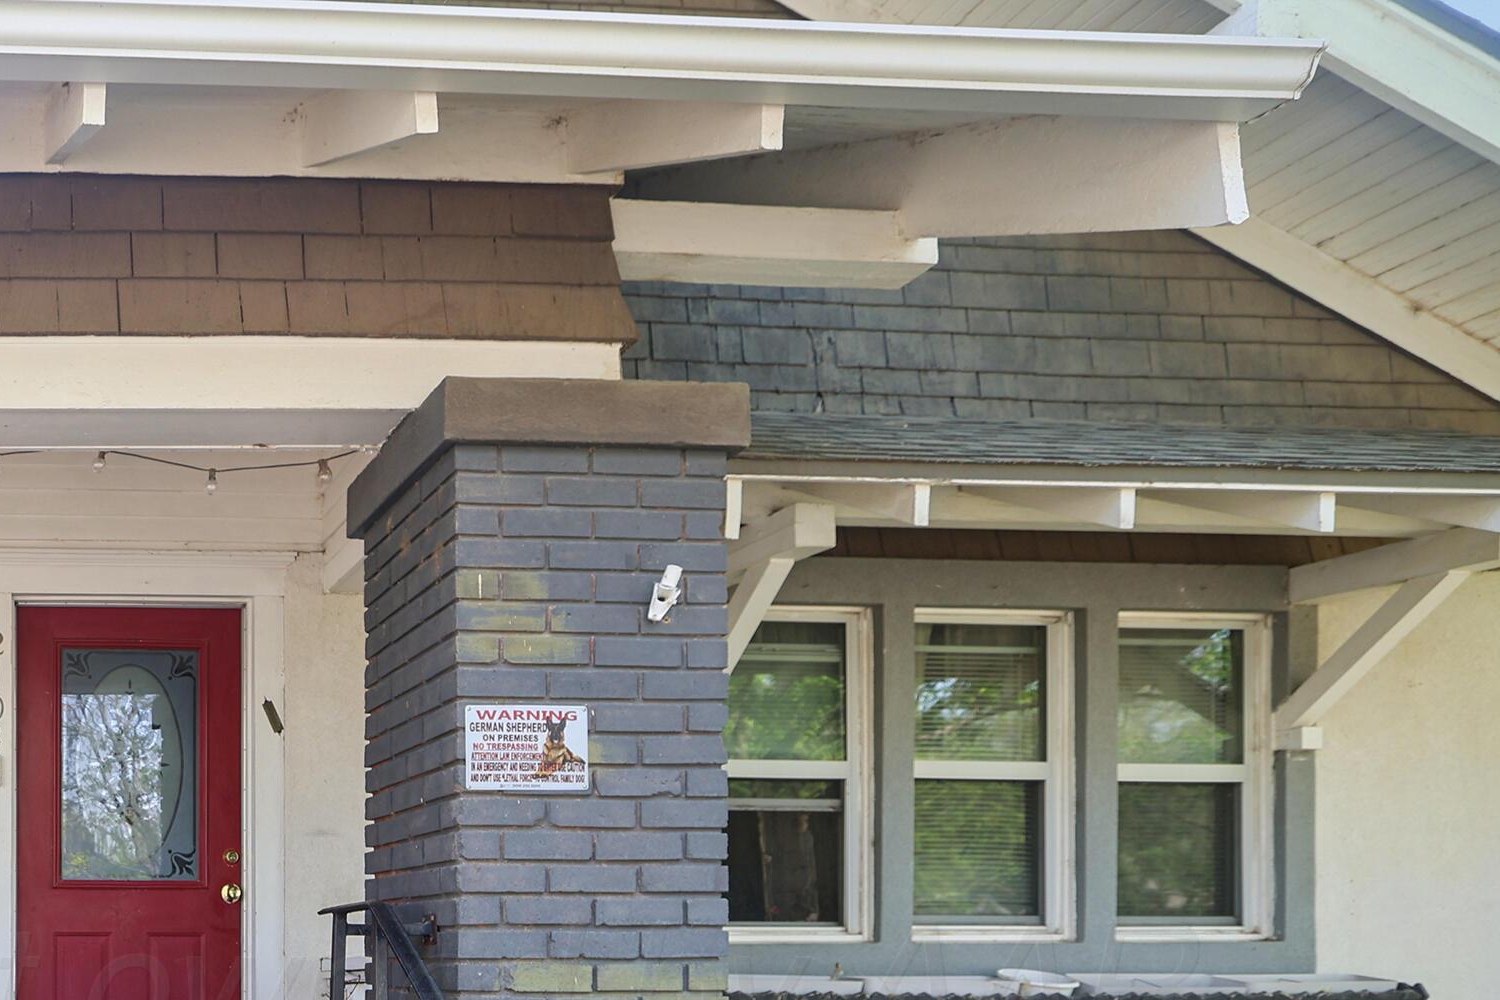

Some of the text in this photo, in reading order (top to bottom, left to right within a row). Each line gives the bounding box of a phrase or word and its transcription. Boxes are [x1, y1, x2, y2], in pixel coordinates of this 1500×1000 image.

[476, 710, 578, 721] WARNING
[469, 722, 547, 733] GERMAN SHEPHERD
[482, 734, 539, 742] ON PREMISES
[473, 742, 539, 751] NO TRESPASSING
[471, 752, 498, 761] ATTENTION
[500, 752, 510, 761] LAW
[471, 762, 476, 772] IN
[476, 762, 483, 772] AN
[483, 762, 509, 772] EMERGENCY
[510, 762, 518, 772] AND
[519, 762, 536, 772] NEEDING
[470, 773, 479, 783] AND
[493, 773, 501, 783] USE
[560, 773, 575, 783] FAMILY
